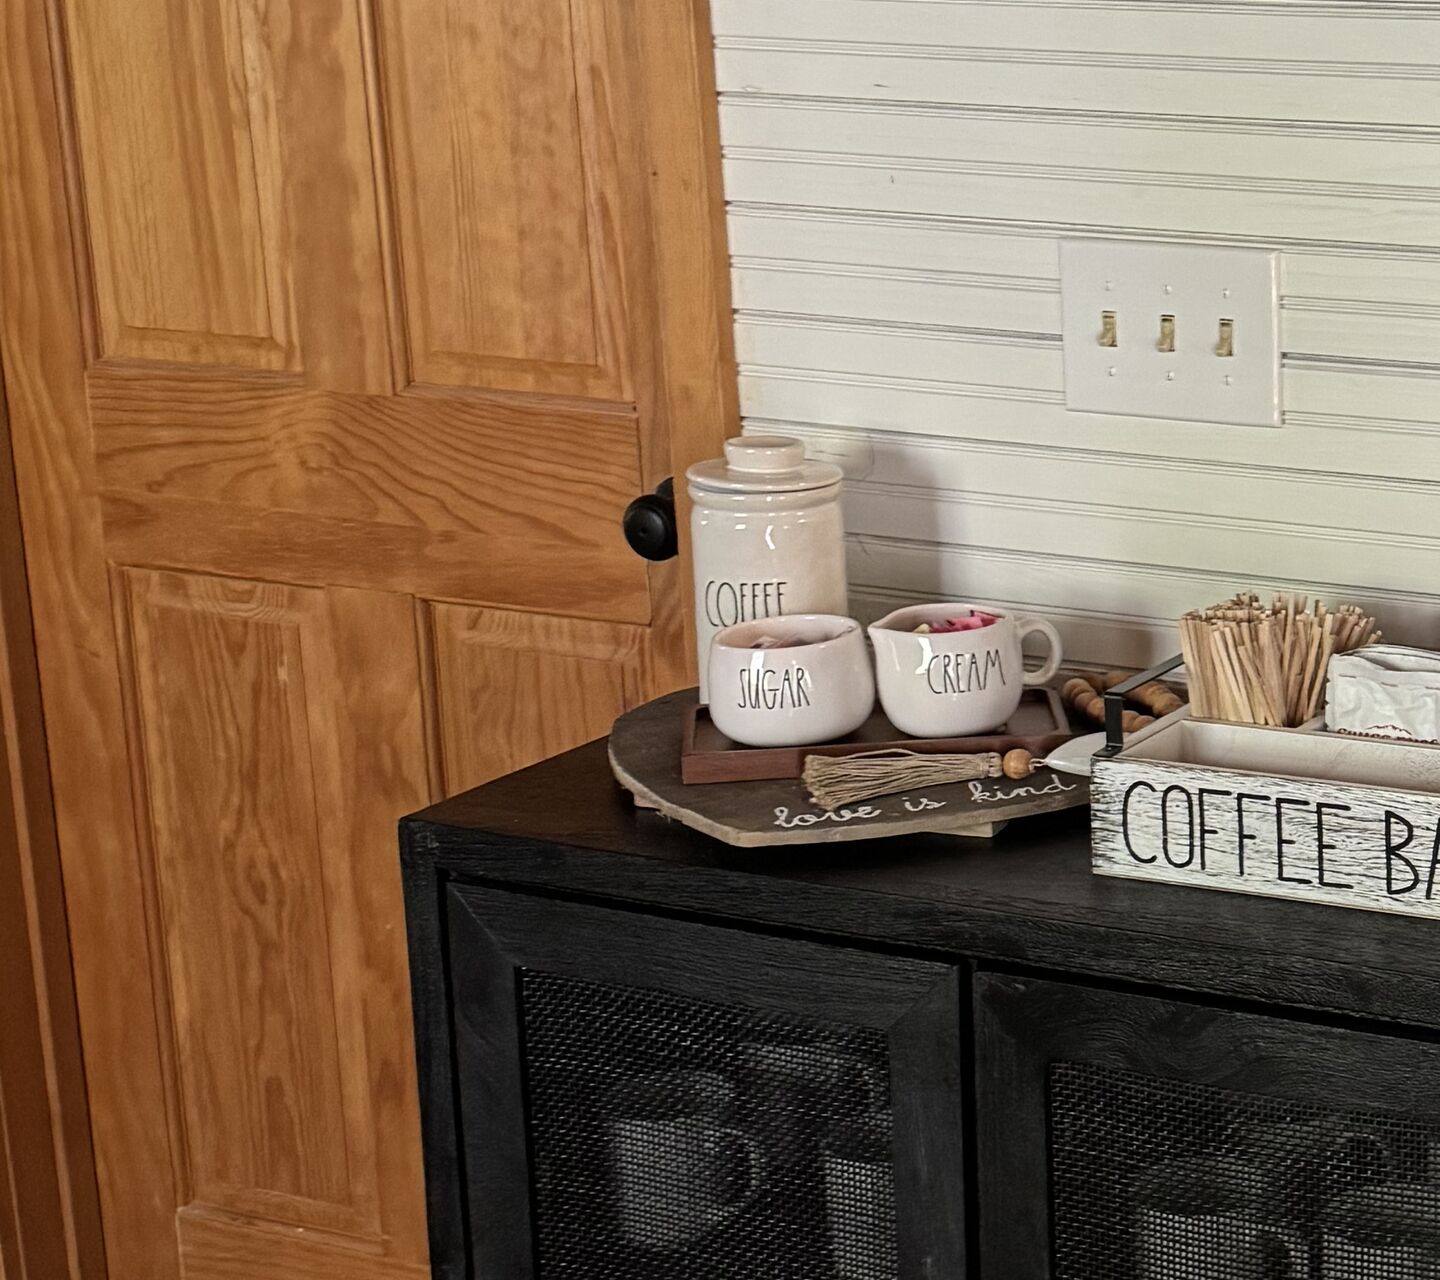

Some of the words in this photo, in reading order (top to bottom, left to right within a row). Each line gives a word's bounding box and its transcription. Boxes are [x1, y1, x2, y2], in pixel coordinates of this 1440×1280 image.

[705, 580, 788, 628] COFFEE
[737, 666, 811, 710] SUGAR
[926, 648, 1007, 695] CREAM
[773, 805, 883, 828] love
[901, 796, 947, 812] is
[967, 773, 1077, 804] kind
[1122, 780, 1354, 890] COFFEE
